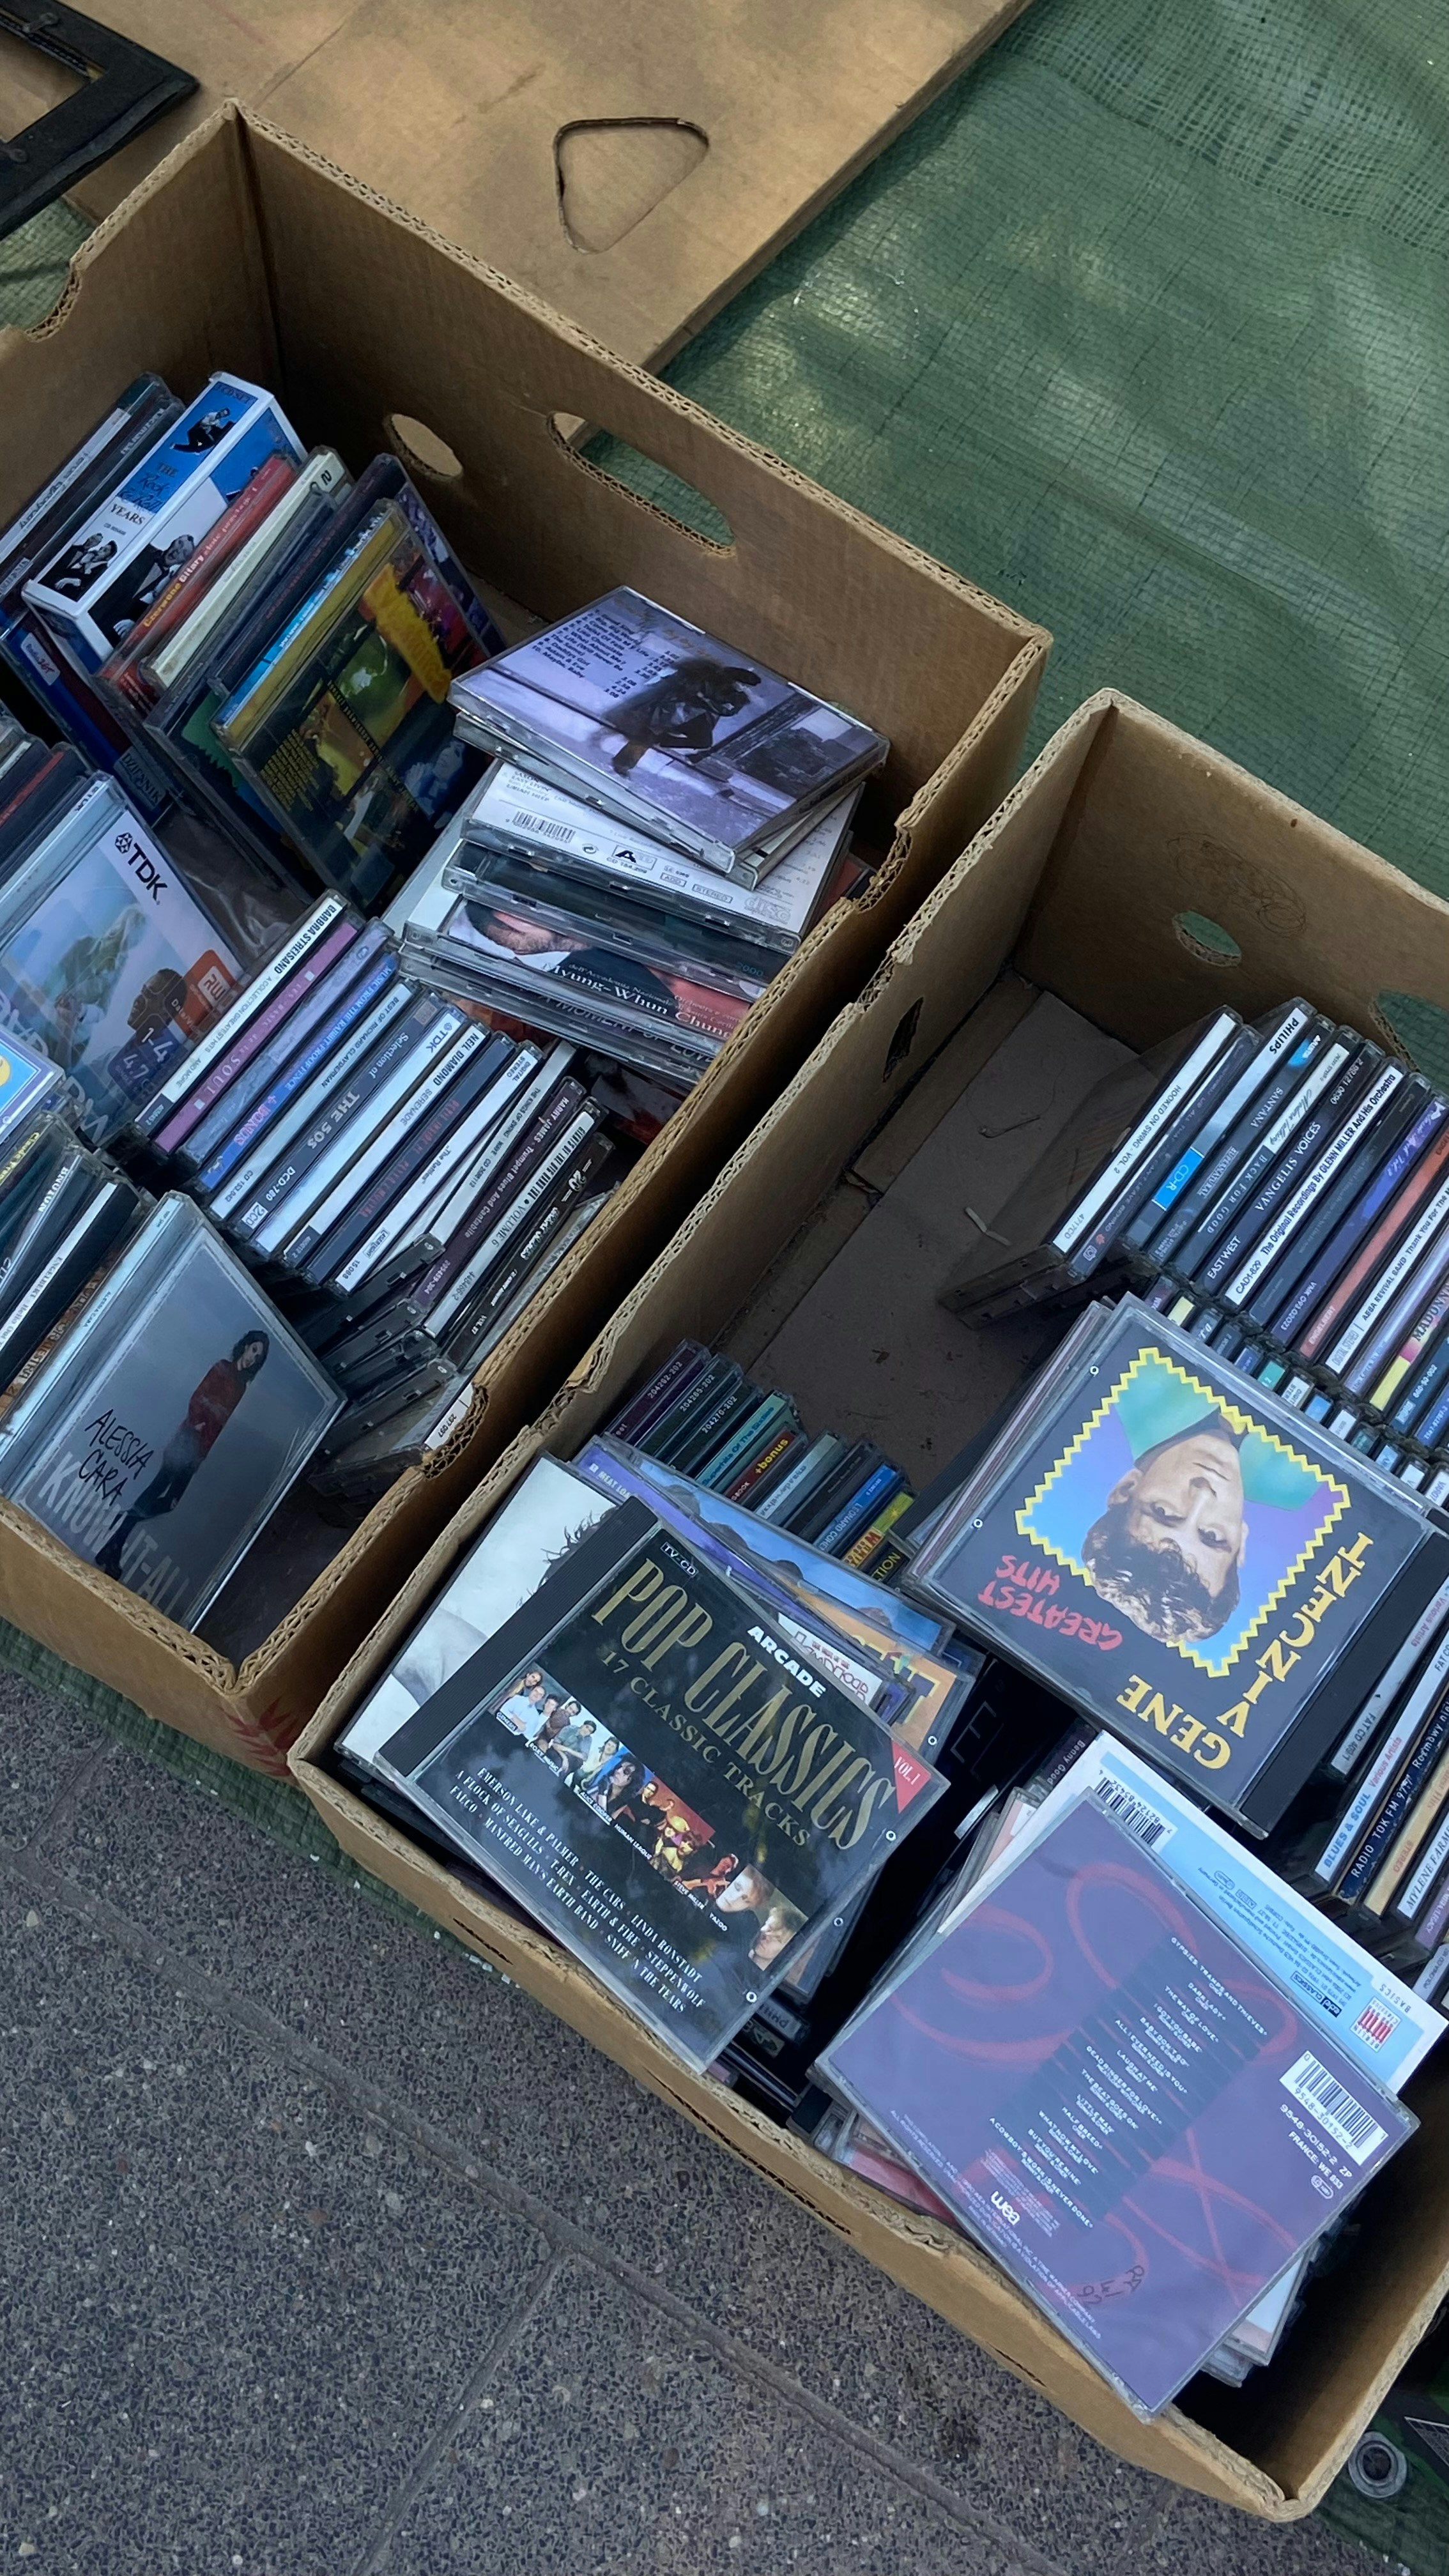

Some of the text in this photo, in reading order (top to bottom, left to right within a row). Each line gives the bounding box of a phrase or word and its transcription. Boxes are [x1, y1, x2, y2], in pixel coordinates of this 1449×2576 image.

[110, 502, 143, 526] YEARS
[119, 842, 171, 901] TDK
[306, 903, 337, 937] BARBRA
[273, 931, 312, 975] STREISAND
[375, 1011, 386, 1023] OF
[382, 995, 399, 1014] BEST
[283, 965, 392, 1091] MUSIC FROM THE RABBIT-PROOF FENCE
[353, 1020, 378, 1049] RICHARD
[425, 1027, 448, 1054] TDK
[1268, 1016, 1299, 1055] PHILIPS
[202, 1054, 242, 1098] SOUL
[320, 1046, 356, 1088] CLAYDERMAN
[366, 1030, 409, 1080] Selection of
[505, 1055, 525, 1078] STEREO
[511, 1060, 531, 1083] DIGITAL
[399, 1031, 479, 1126] NEIL DIAMOND SERENADE
[1368, 1072, 1397, 1106] Orchestra
[305, 1088, 360, 1151] THE 50s
[1148, 1114, 1160, 1126] ON
[1156, 1084, 1182, 1116] HOOKED
[1351, 1113, 1366, 1129] And
[1361, 1102, 1374, 1116] His
[1131, 1124, 1152, 1149] SWING
[1197, 1085, 1284, 1199] SANTANA SUPERNATURAL
[1333, 1125, 1356, 1152] MILLER
[463, 1095, 569, 1240] HARRY JAMES Trumpet Blues And Cantabile
[1164, 1162, 1190, 1193] CD-R
[1254, 1121, 1322, 1213] VANGELIS VOICES
[1312, 1171, 1326, 1184] By
[1318, 1149, 1339, 1174] GLENN
[242, 1165, 295, 1228] DCD-780 2CD
[1205, 1153, 1268, 1236] BACK FOR GOOD
[1287, 1180, 1319, 1219] Recordings
[1260, 1240, 1274, 1255] The
[1268, 1215, 1294, 1244] Original
[1207, 1235, 1241, 1279] EAST WEST
[1360, 1194, 1448, 1321] ABBA REVIVAL BAND Thank You For The
[1307, 1305, 1338, 1345] ENGELBERT
[84, 1409, 154, 1480] ALESSIA
[701, 1451, 733, 1486] Superhits
[730, 1442, 741, 1453] Of
[739, 1429, 753, 1444] The
[752, 1435, 790, 1476] +bonus
[79, 1450, 128, 1506] CARA
[834, 1502, 862, 1533] LEONARD
[660, 1544, 698, 1577] TV-CD
[995, 1554, 1061, 1597] HITS
[977, 1580, 1124, 1651] GREATEST
[1216, 1532, 1374, 1738] VINCENT
[746, 1627, 828, 1699] ARCADE
[1354, 1595, 1447, 1742] Various Artists FAT CD
[590, 1558, 898, 1853] POP CLASSICS
[1116, 1674, 1232, 1769] GENE
[601, 1649, 811, 1848] 17 CLASSIC TRACKS
[1321, 1735, 1404, 1868] BLUES & SOUL Various Artists
[612, 1823, 654, 1860] HUMAN LEAGUE
[1348, 1843, 1377, 1878] RADIO
[1371, 1816, 1392, 1840] TOK
[1383, 1799, 1401, 1818] FM
[454, 1768, 466, 1781] A
[460, 1775, 494, 1806] FLOCK
[489, 1801, 507, 1819] OF
[500, 1813, 546, 1856] SEAGULLS
[578, 1888, 613, 1920] EARTH
[608, 1915, 620, 1928] &
[615, 1923, 641, 1948] FIRE
[643, 1949, 707, 2011] STEPPENWOLF
[475, 1766, 705, 1984] EMERSON LAKE & PALMER THE CARS LINDA RONSTADT
[672, 1879, 707, 1910] STEVE MILLER
[1402, 1863, 1437, 1909] MYLENE
[448, 1785, 479, 1814] FALCO
[480, 1816, 525, 1857] MANFRED
[519, 1853, 549, 1882] MAN'S
[544, 1877, 577, 1908] EARTH
[572, 1904, 601, 1931] BAND
[602, 1933, 632, 1961] SNIFF
[637, 1966, 660, 1988] THE
[656, 1984, 688, 2014] TEARS
[707, 1912, 729, 1931] YAZOO
[1198, 1965, 1225, 1993] TRAMPS
[1223, 1991, 1239, 2007] AND
[1377, 1982, 1412, 2012] BASICS
[1351, 2023, 1381, 2049] BERLIN
[1278, 2103, 1353, 2180] 9548-30152-2 ZP
[988, 2190, 1022, 2225] wea
